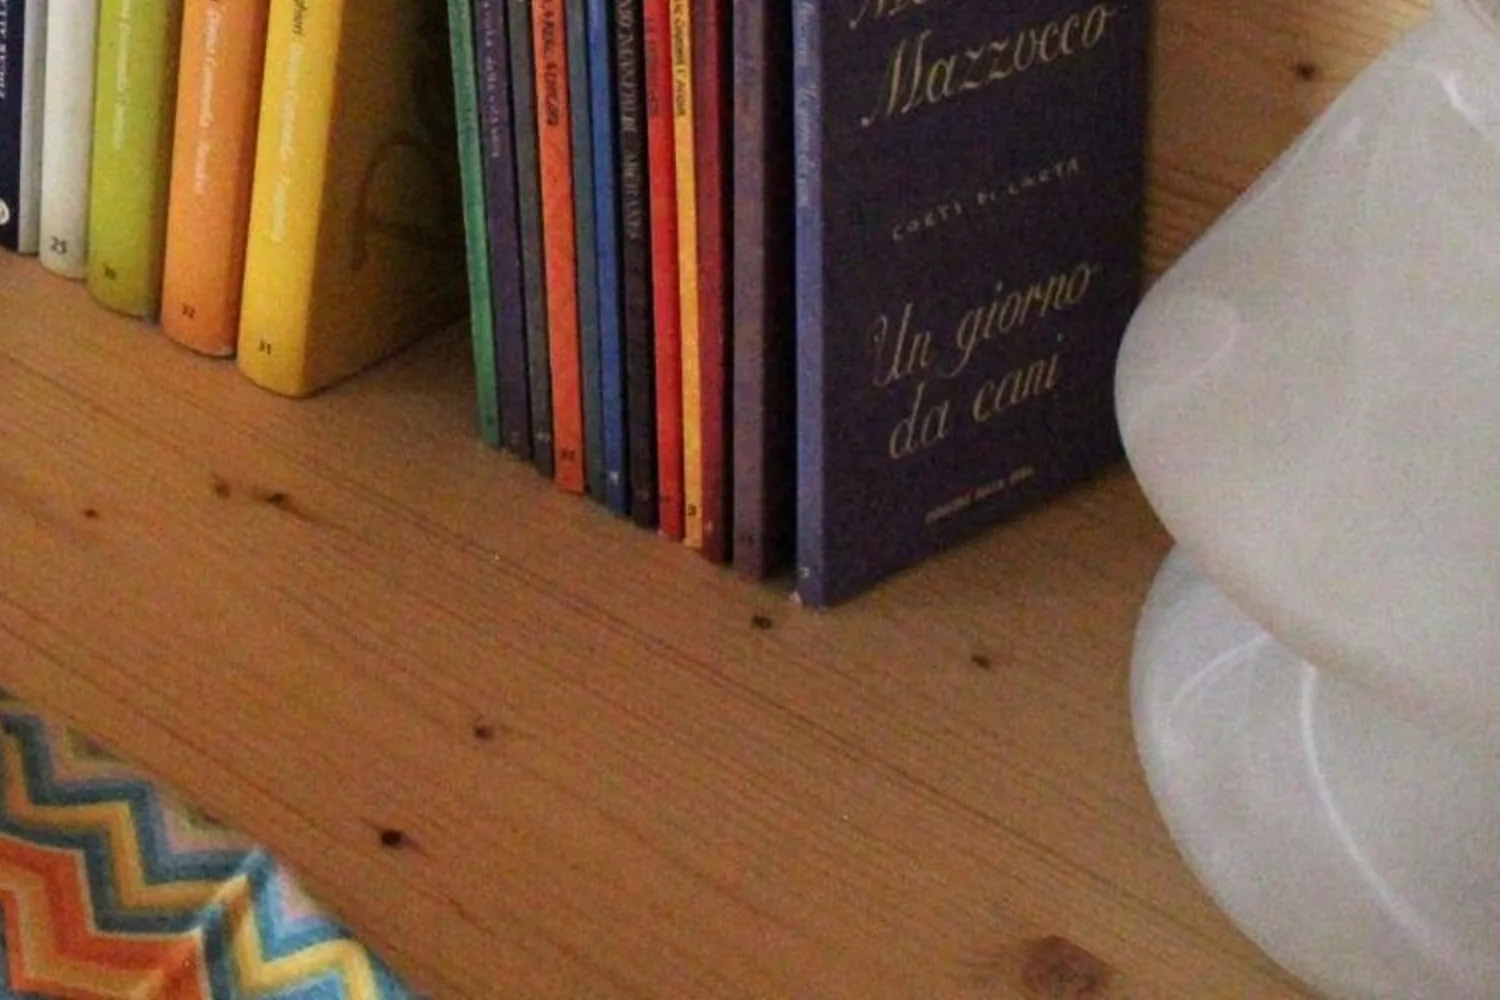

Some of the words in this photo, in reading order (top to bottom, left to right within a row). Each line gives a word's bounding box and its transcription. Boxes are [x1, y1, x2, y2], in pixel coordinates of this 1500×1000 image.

[861, 3, 1120, 127] Mazzucco
[868, 302, 931, 386] Un
[940, 263, 1098, 379] giorno
[889, 381, 950, 460] da
[972, 332, 1064, 422] cani
